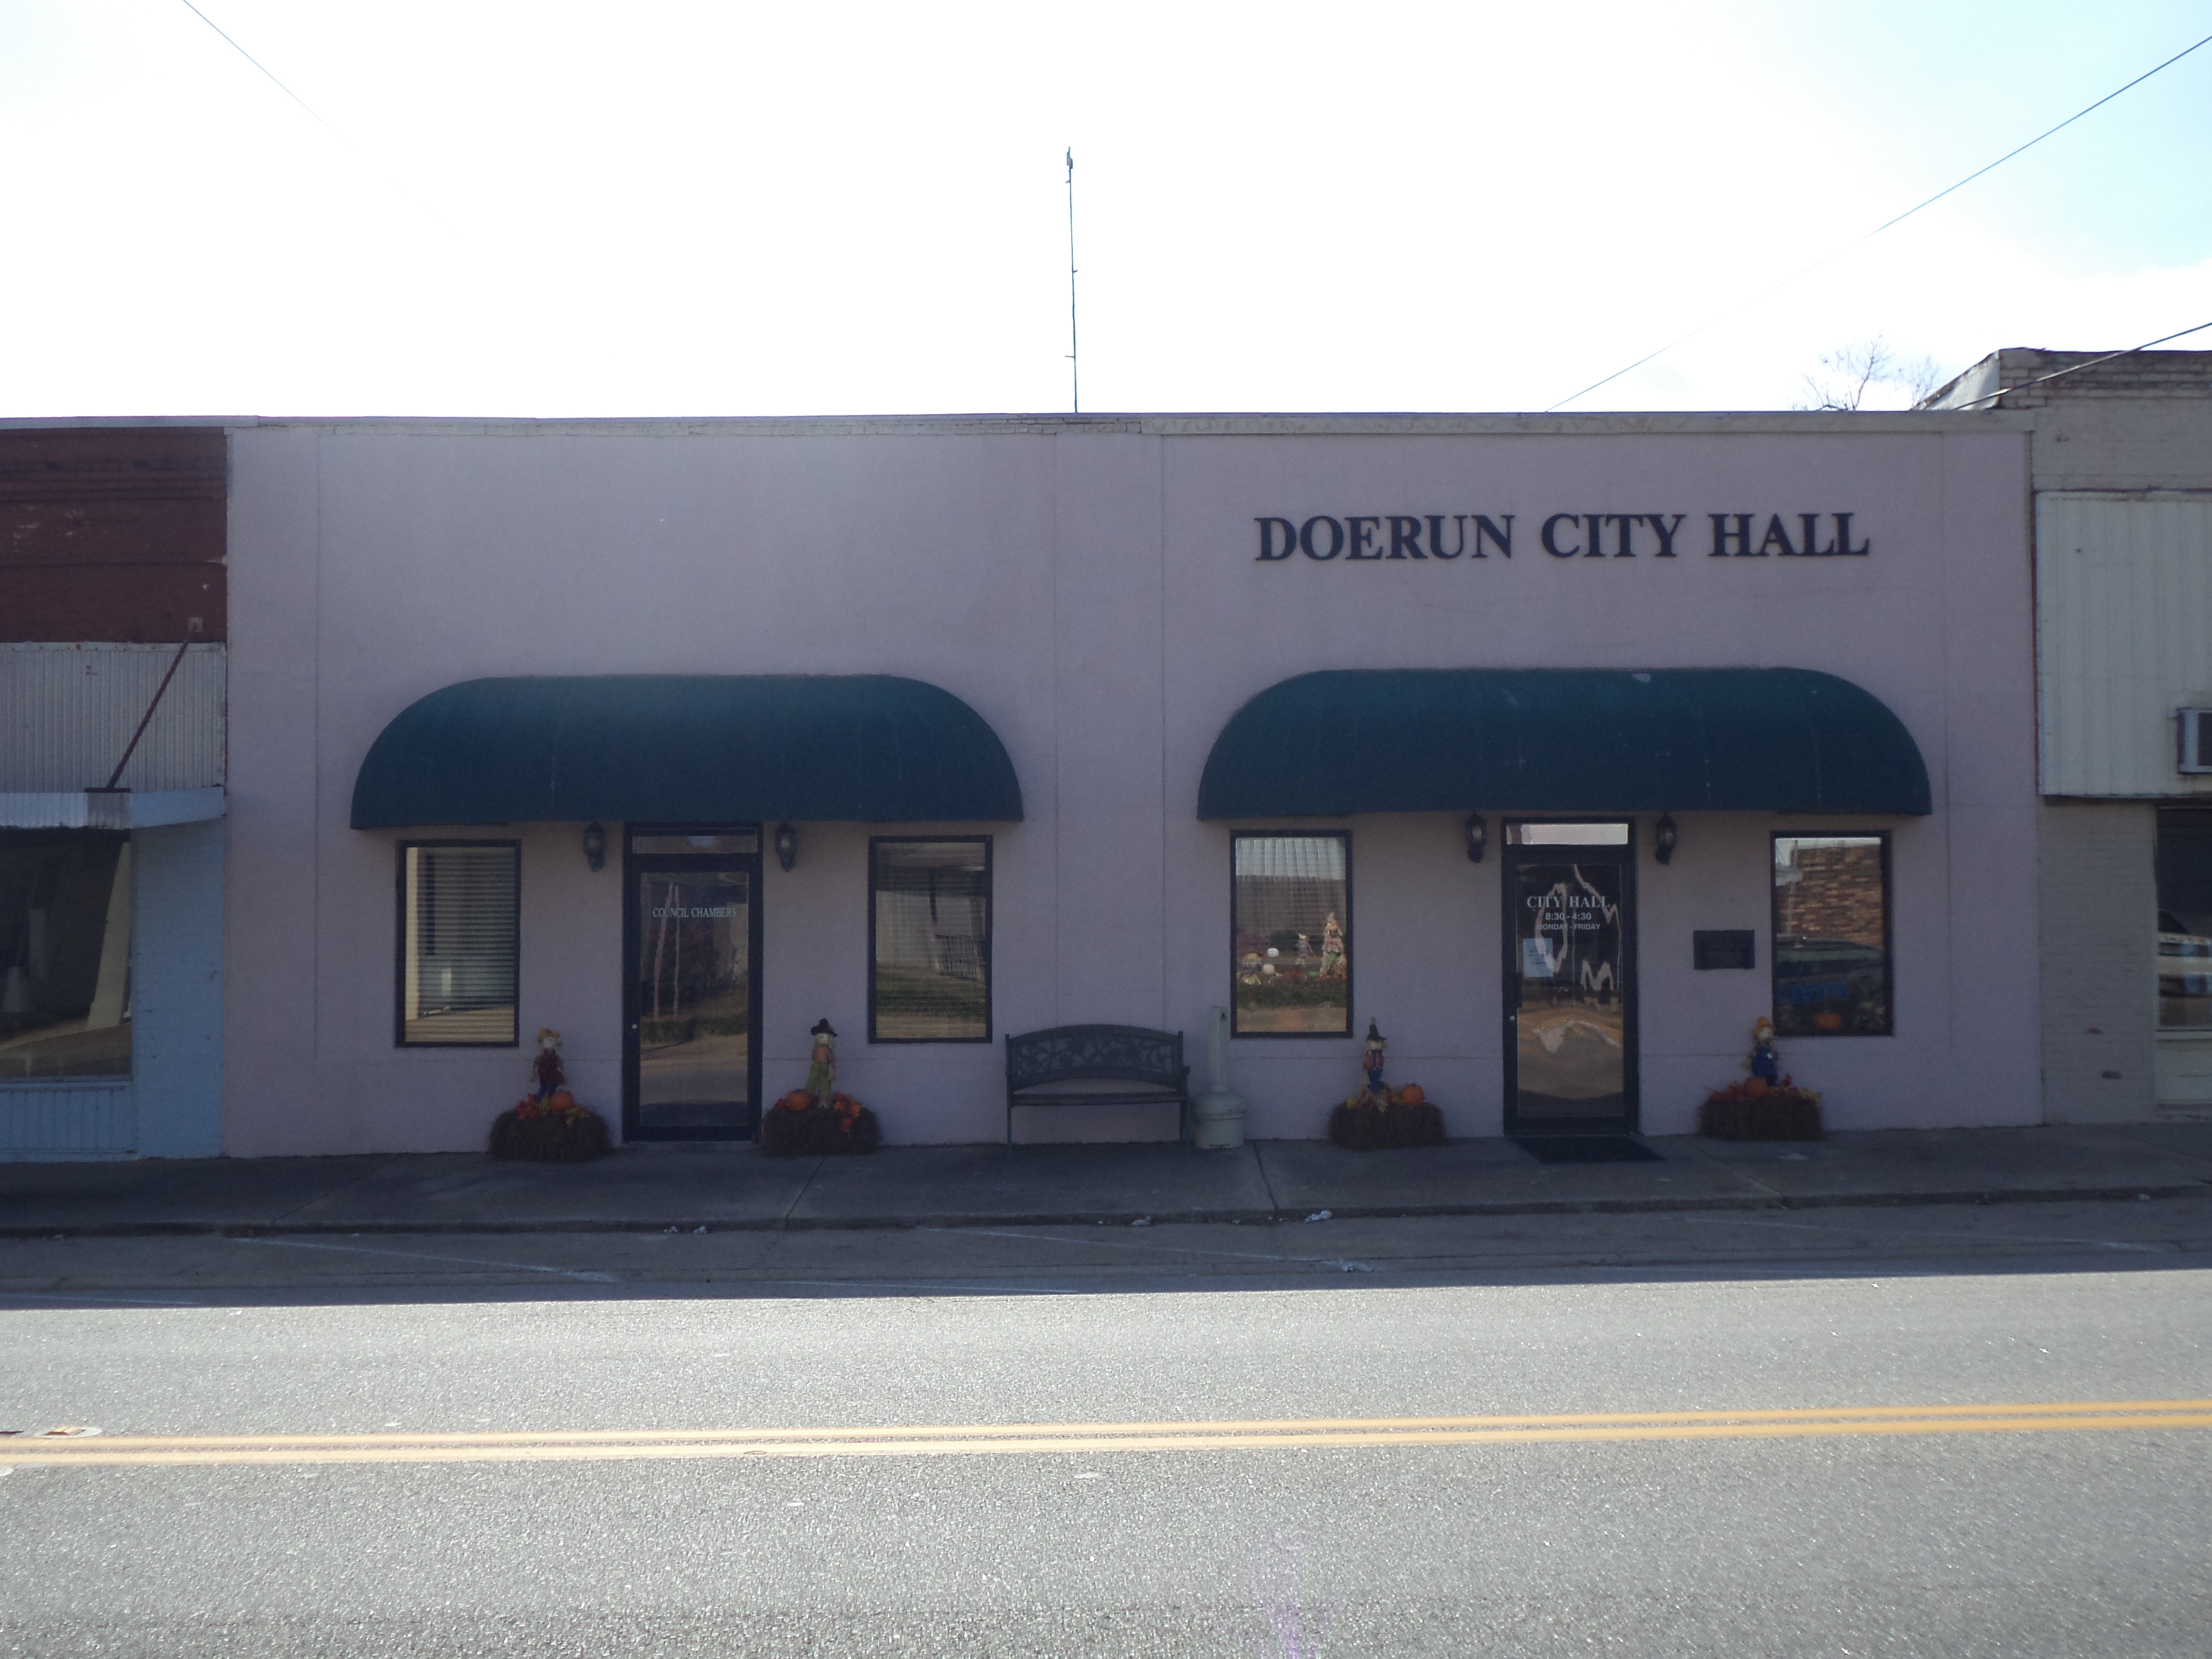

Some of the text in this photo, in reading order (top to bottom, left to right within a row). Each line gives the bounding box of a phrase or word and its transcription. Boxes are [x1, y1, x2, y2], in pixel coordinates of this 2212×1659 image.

[1254, 512, 1870, 561] DOERUN CITY HALL
[1526, 896, 1610, 908] CITY HALL
[652, 908, 737, 918] COUNCIL CHAMBERS
